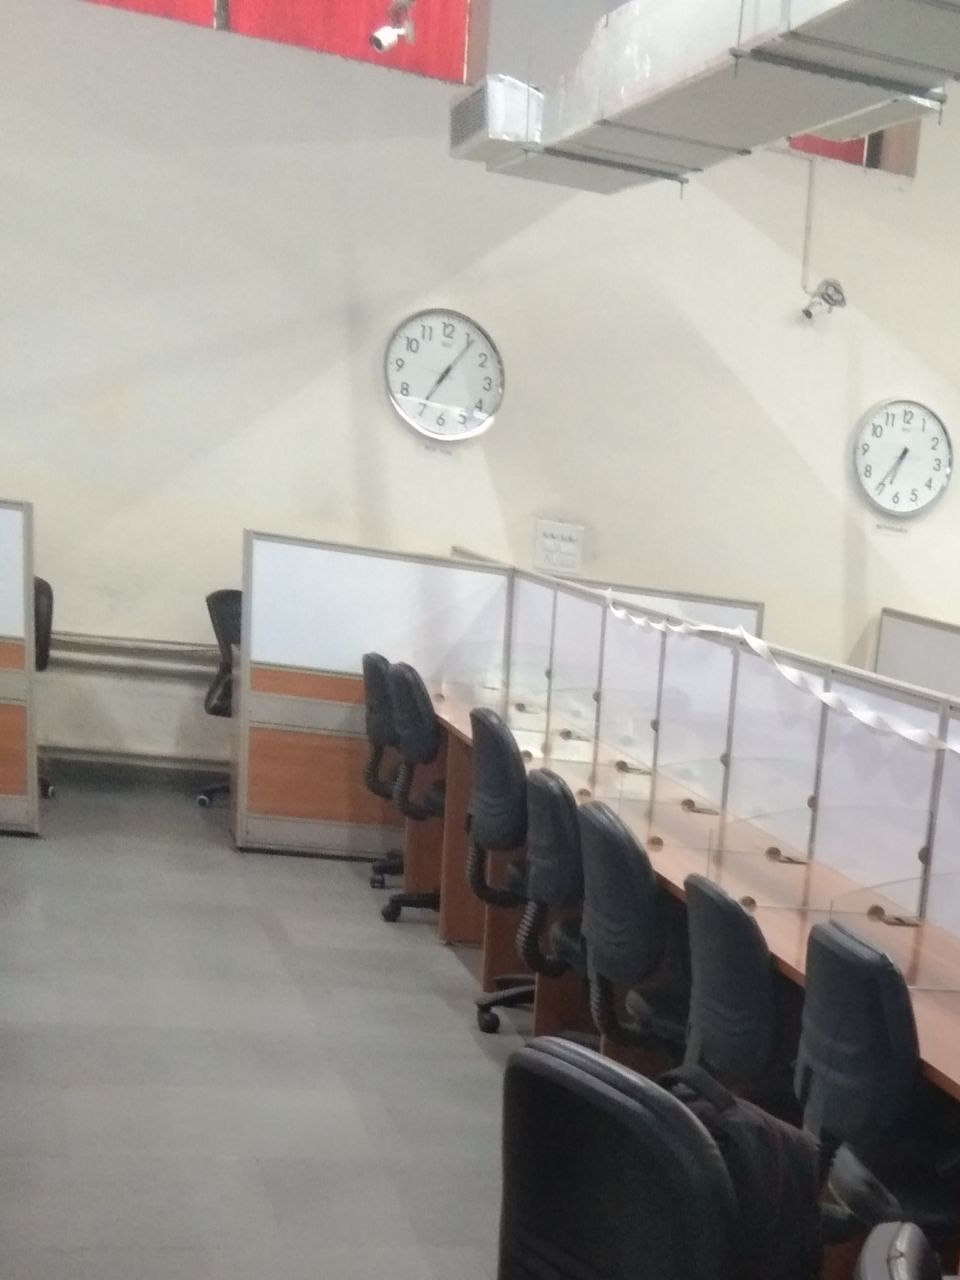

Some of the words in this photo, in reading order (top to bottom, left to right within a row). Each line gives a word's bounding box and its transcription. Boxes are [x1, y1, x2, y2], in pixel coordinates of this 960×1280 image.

[420, 324, 433, 341] 11
[441, 321, 456, 339] 12
[405, 336, 419, 353] 10
[395, 358, 405, 372] 9
[478, 352, 489, 368] 2
[400, 381, 410, 397] 8
[482, 376, 492, 391] 3
[418, 402, 428, 417] 7
[475, 398, 484, 412] 4
[436, 413, 446, 426] 6
[884, 411, 896, 428] 11
[902, 409, 914, 425] 12
[871, 422, 884, 439] 10
[922, 418, 926, 432] 1
[862, 443, 870, 456] 9
[931, 436, 940, 451] 2
[864, 464, 872, 478] 8
[933, 457, 942, 472] 3
[925, 477, 933, 491] 4
[892, 492, 900, 504] 6
[909, 488, 918, 503] 5
